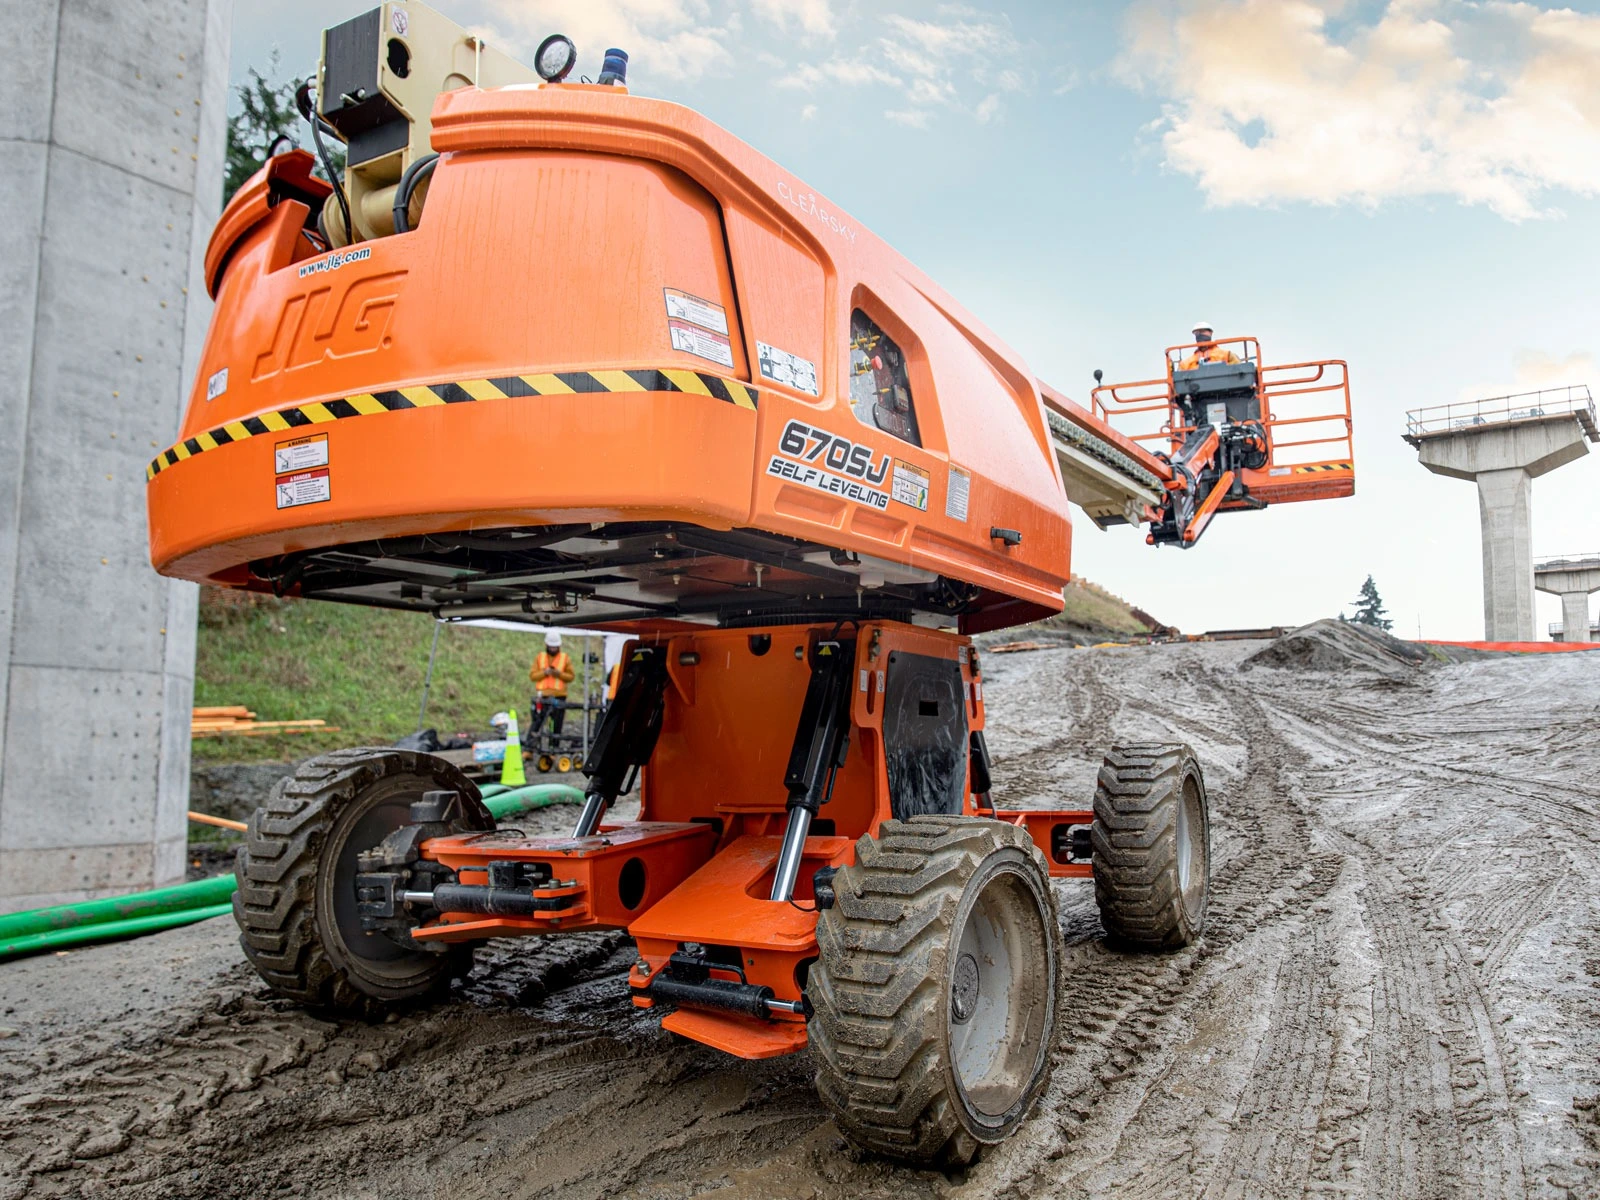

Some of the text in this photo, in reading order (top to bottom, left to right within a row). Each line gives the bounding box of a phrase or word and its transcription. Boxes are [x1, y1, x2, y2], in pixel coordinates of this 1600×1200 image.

[777, 182, 856, 244] CLEARSKY
[299, 248, 371, 277] www.jlg.com
[780, 421, 890, 484] 670SJ
[769, 458, 817, 482] SELF
[818, 474, 889, 508] LEVELING
